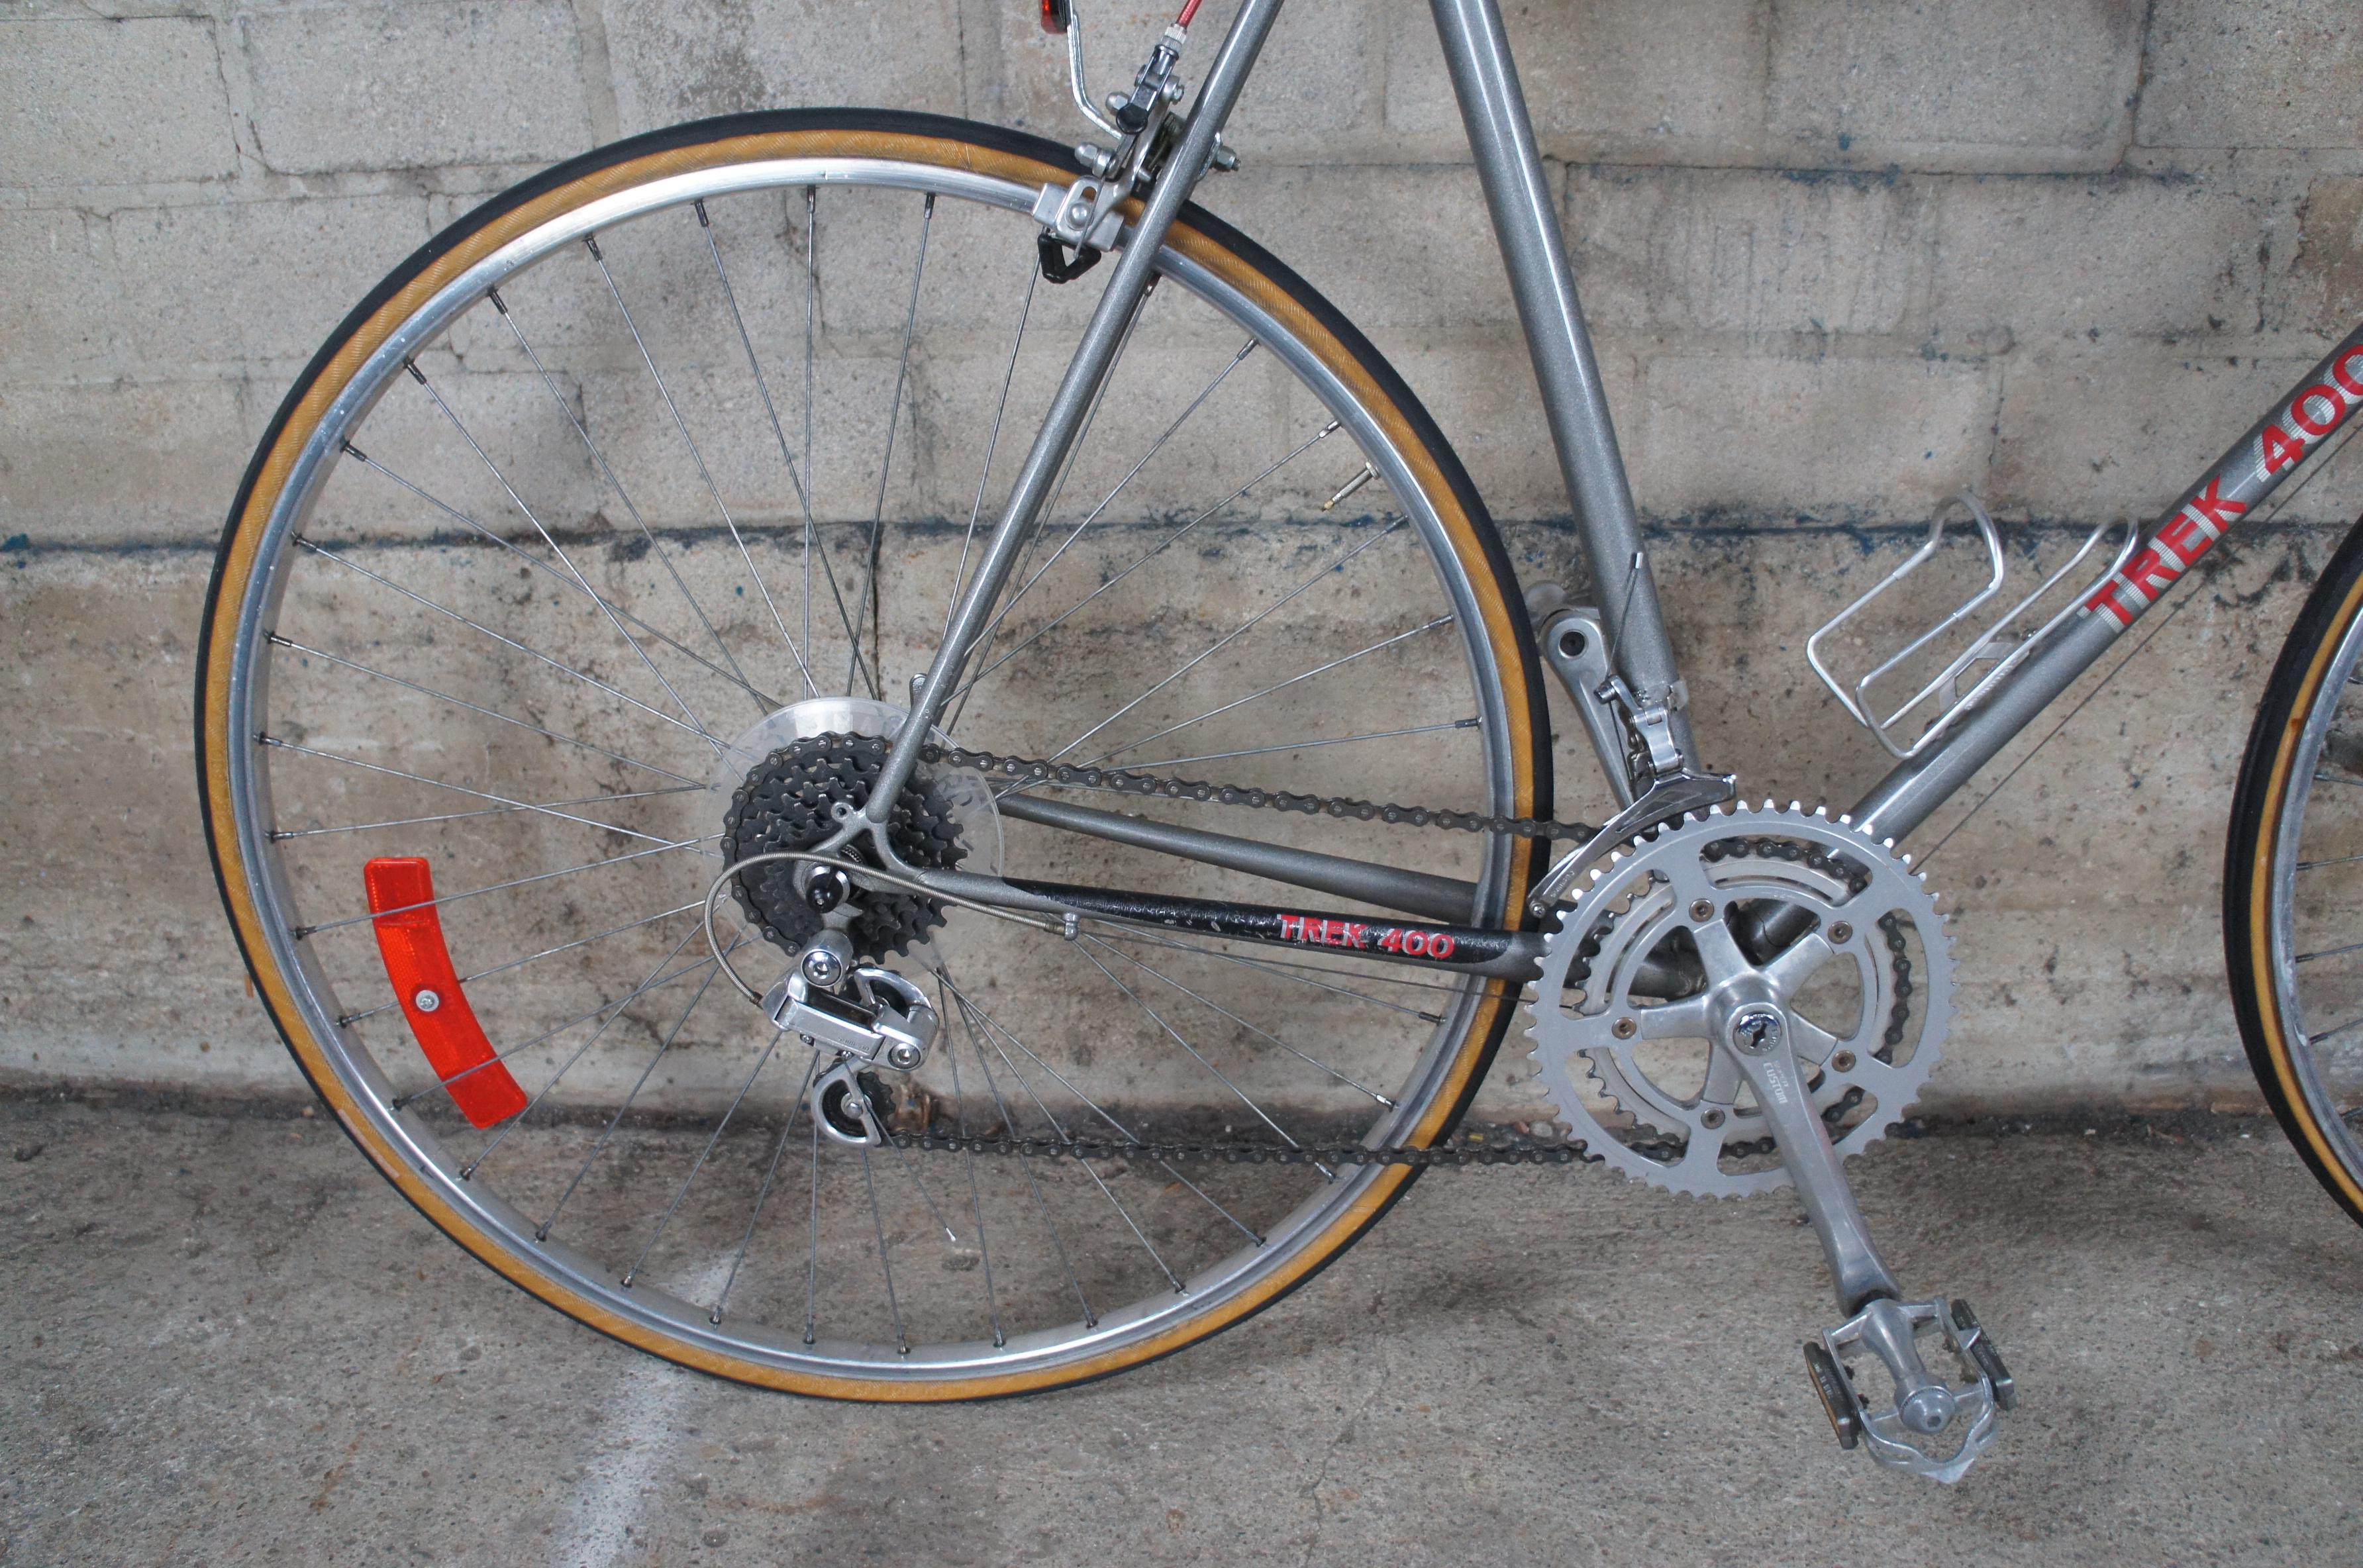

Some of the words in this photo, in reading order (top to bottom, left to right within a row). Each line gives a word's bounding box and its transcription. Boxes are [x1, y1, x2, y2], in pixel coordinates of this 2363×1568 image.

[2076, 473, 2247, 633] TREK
[1277, 913, 1368, 949] TREK
[1378, 928, 1455, 959] 400
[1763, 1062, 1787, 1104] CUSTOM
